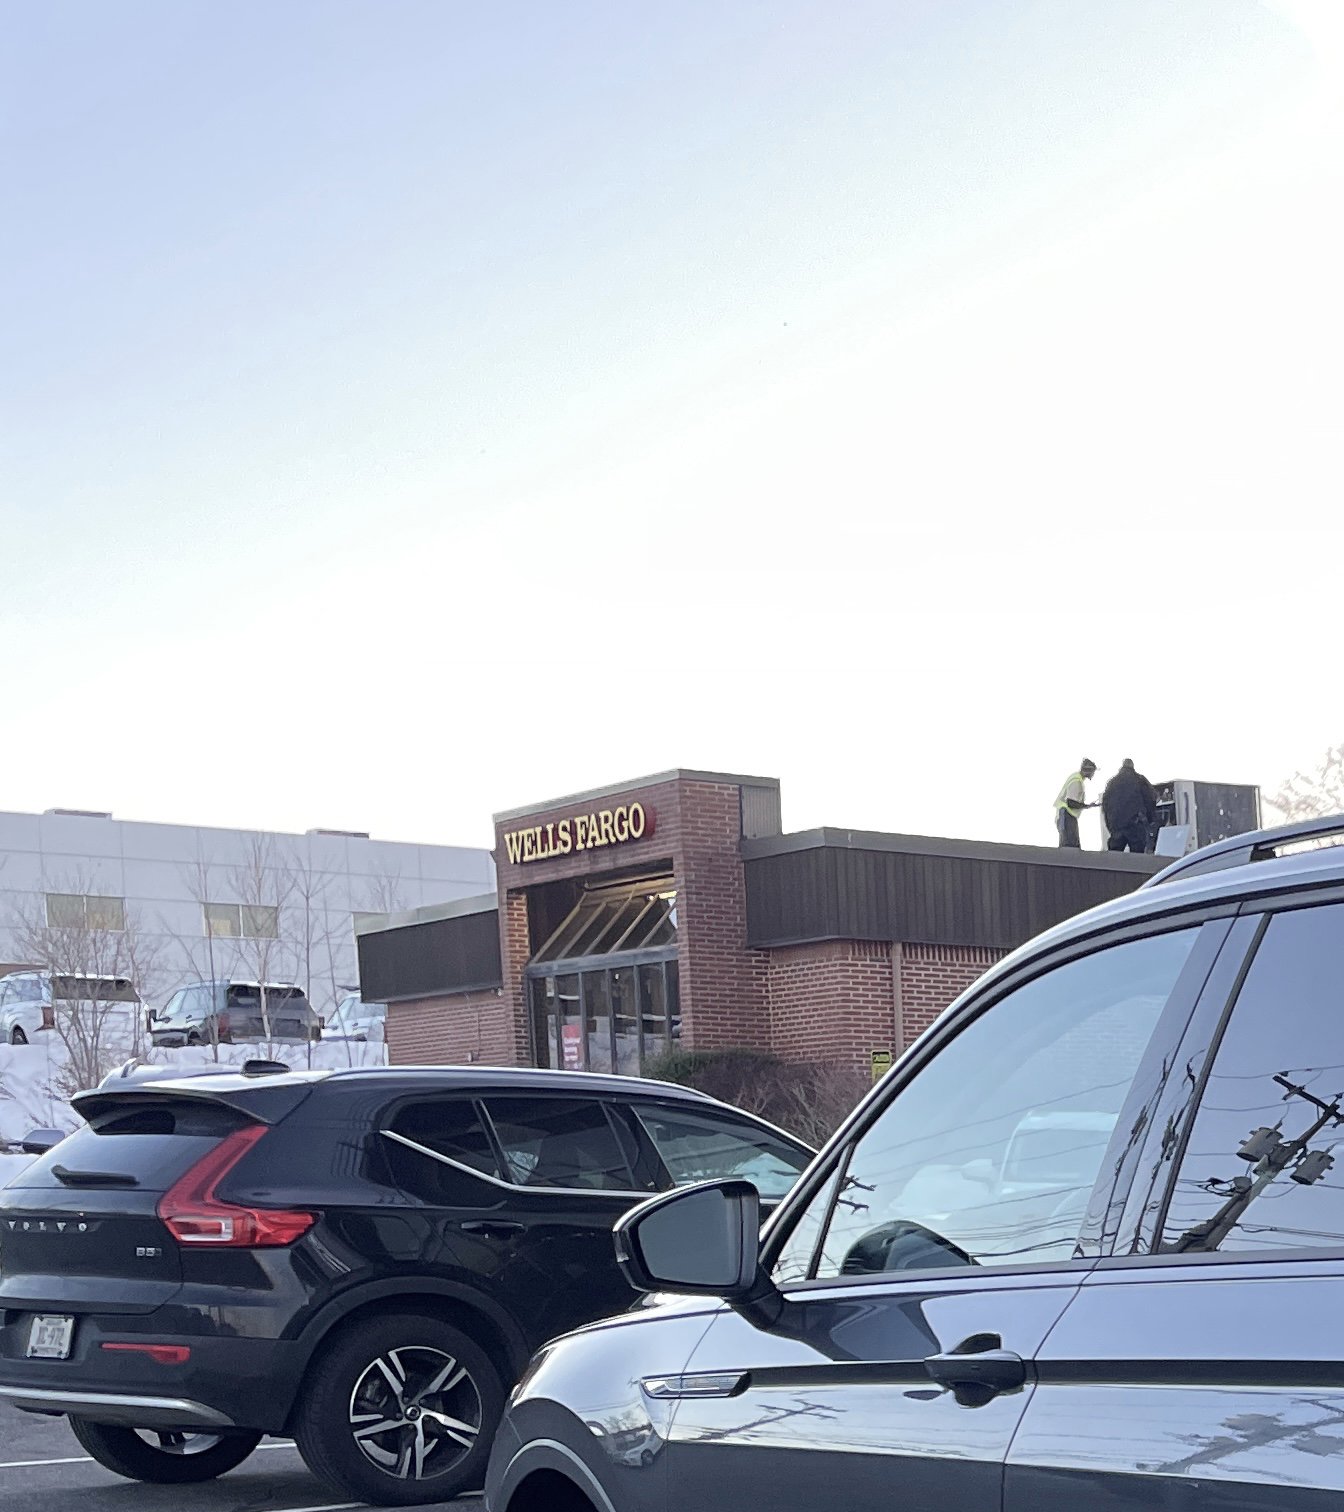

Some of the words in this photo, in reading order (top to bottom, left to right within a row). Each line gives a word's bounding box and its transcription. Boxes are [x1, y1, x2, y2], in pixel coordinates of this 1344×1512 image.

[504, 819, 572, 865] WELLS
[575, 802, 646, 851] FARGO
[8, 1220, 88, 1233] VOLVO
